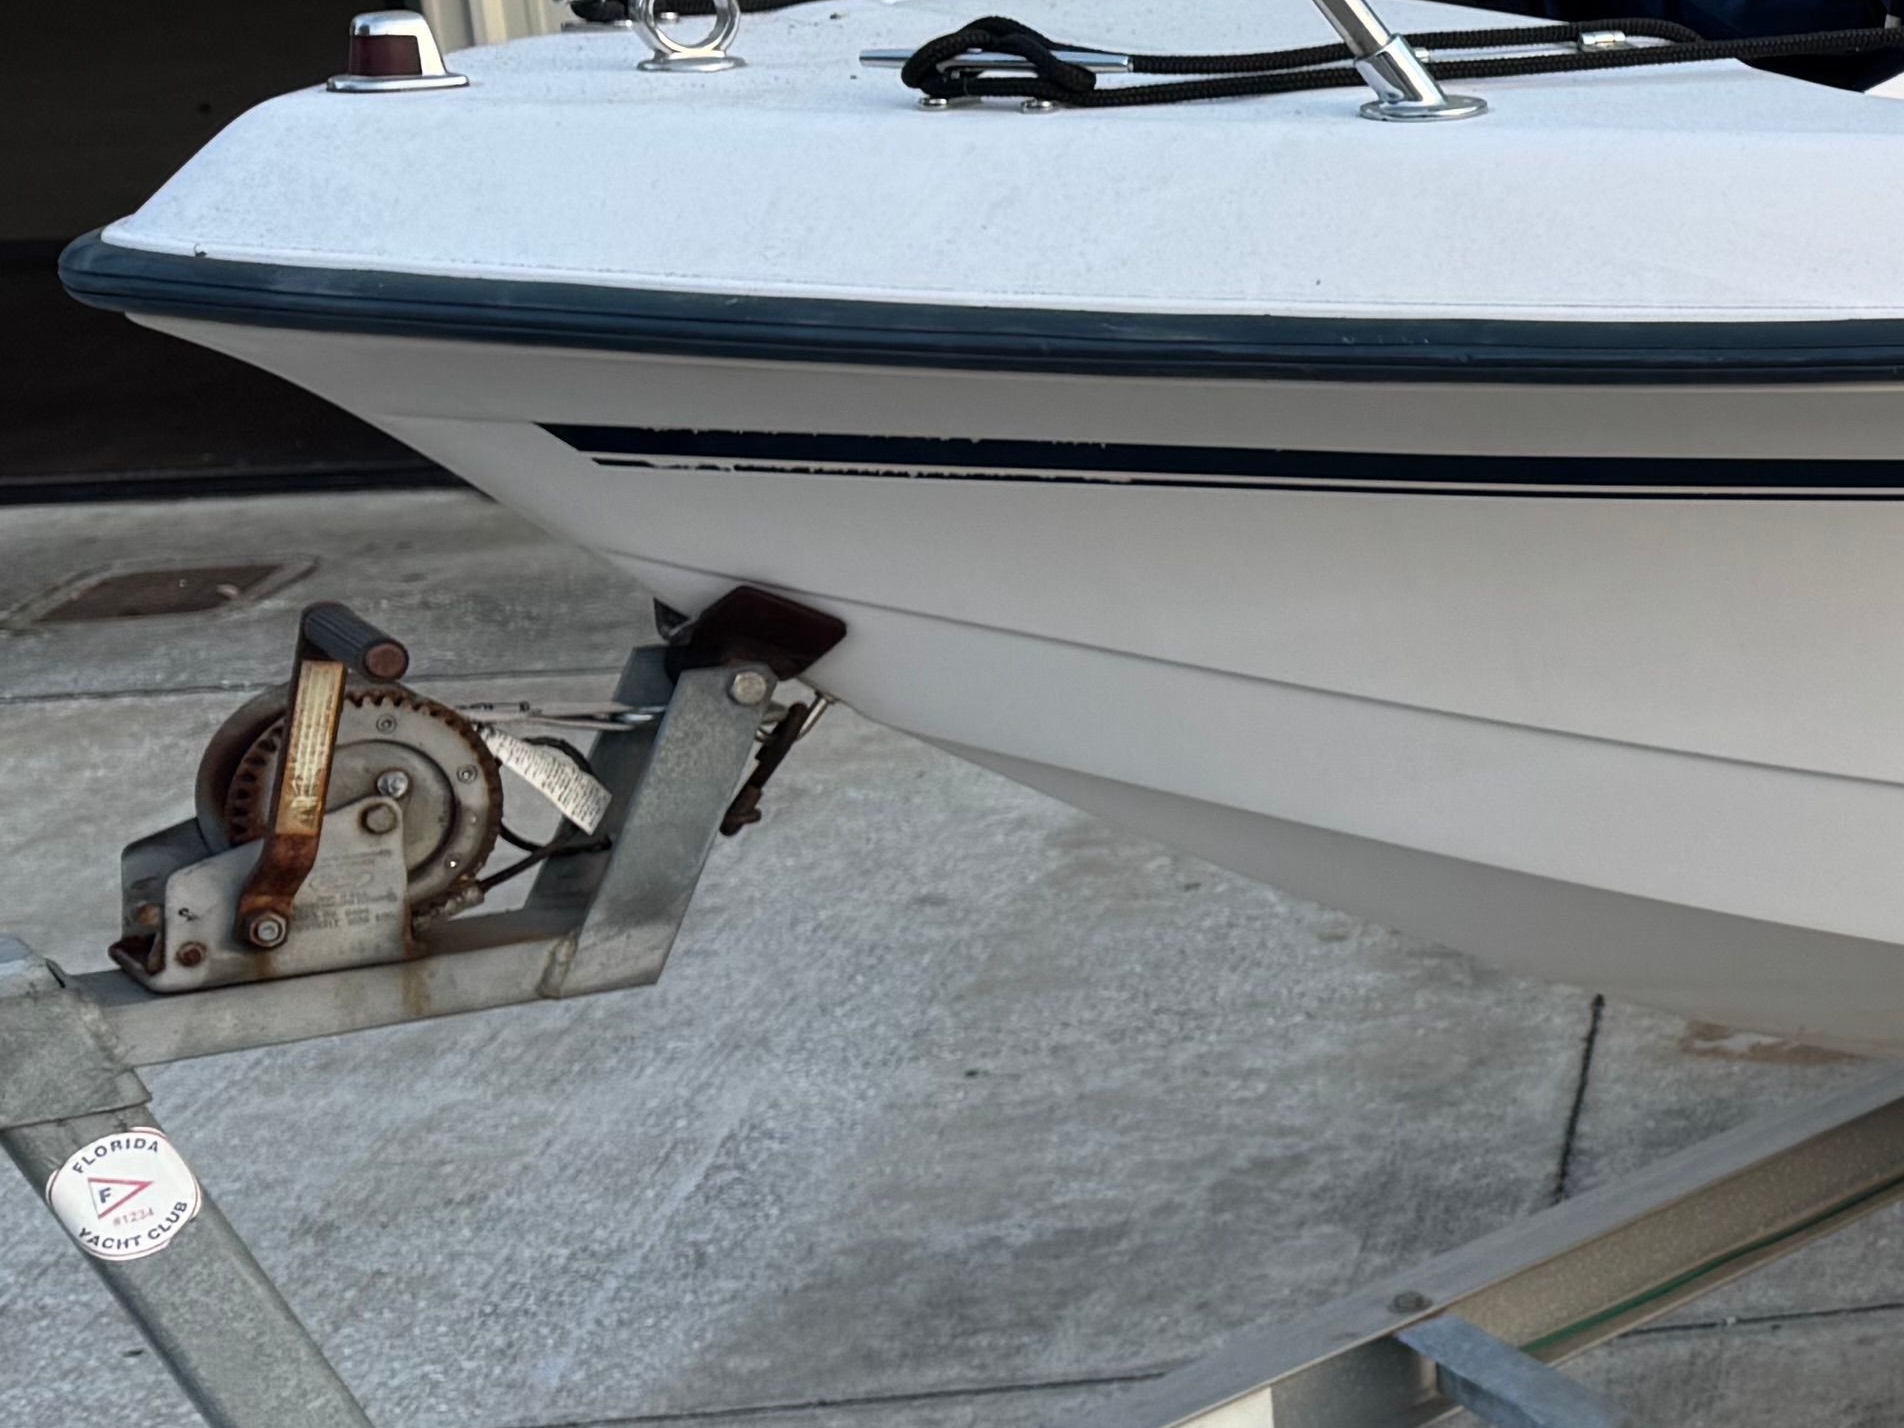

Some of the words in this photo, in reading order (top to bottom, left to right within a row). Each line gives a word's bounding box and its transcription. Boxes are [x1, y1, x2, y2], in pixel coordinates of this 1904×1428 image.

[73, 1138, 158, 1173] FLORIDA
[80, 1228, 141, 1249] YACHT
[148, 1201, 188, 1240] CLUB
